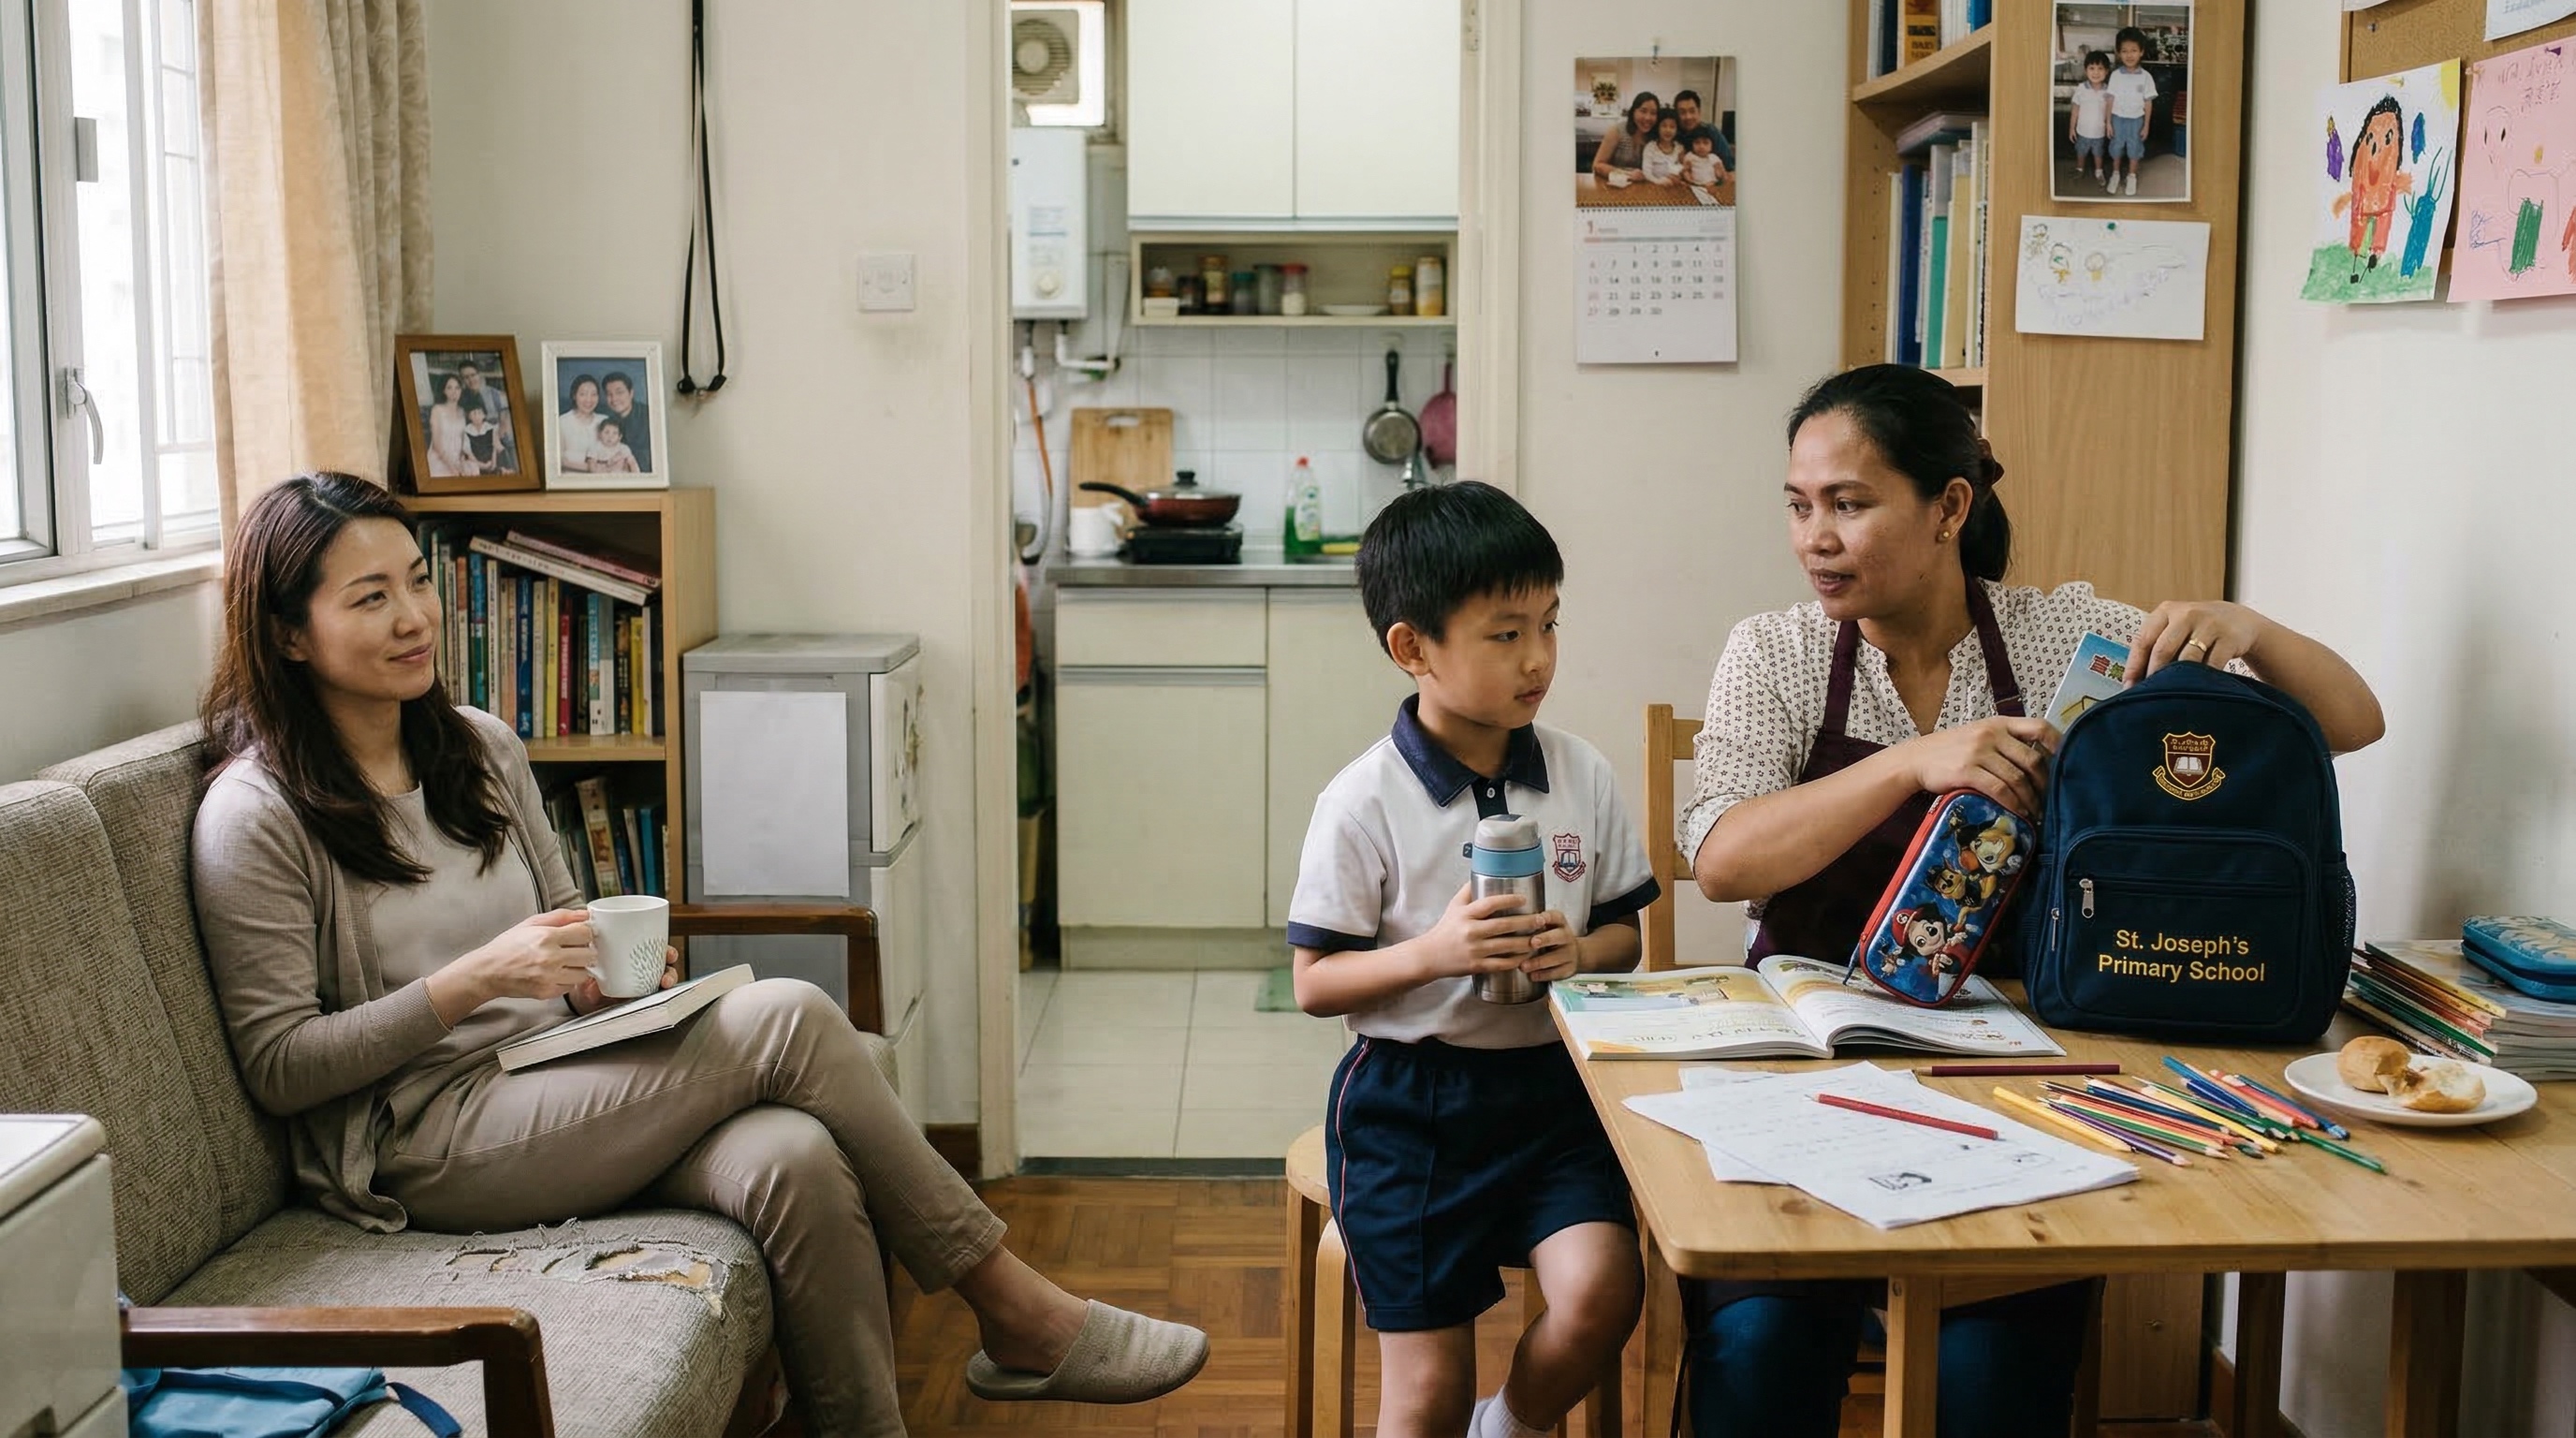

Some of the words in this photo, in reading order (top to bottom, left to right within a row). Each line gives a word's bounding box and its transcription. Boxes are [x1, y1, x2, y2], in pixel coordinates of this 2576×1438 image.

[2115, 929, 2144, 949] St.
[2150, 932, 2249, 959] Joseph's
[2098, 954, 2183, 983] Primary
[2188, 961, 2265, 981] School
